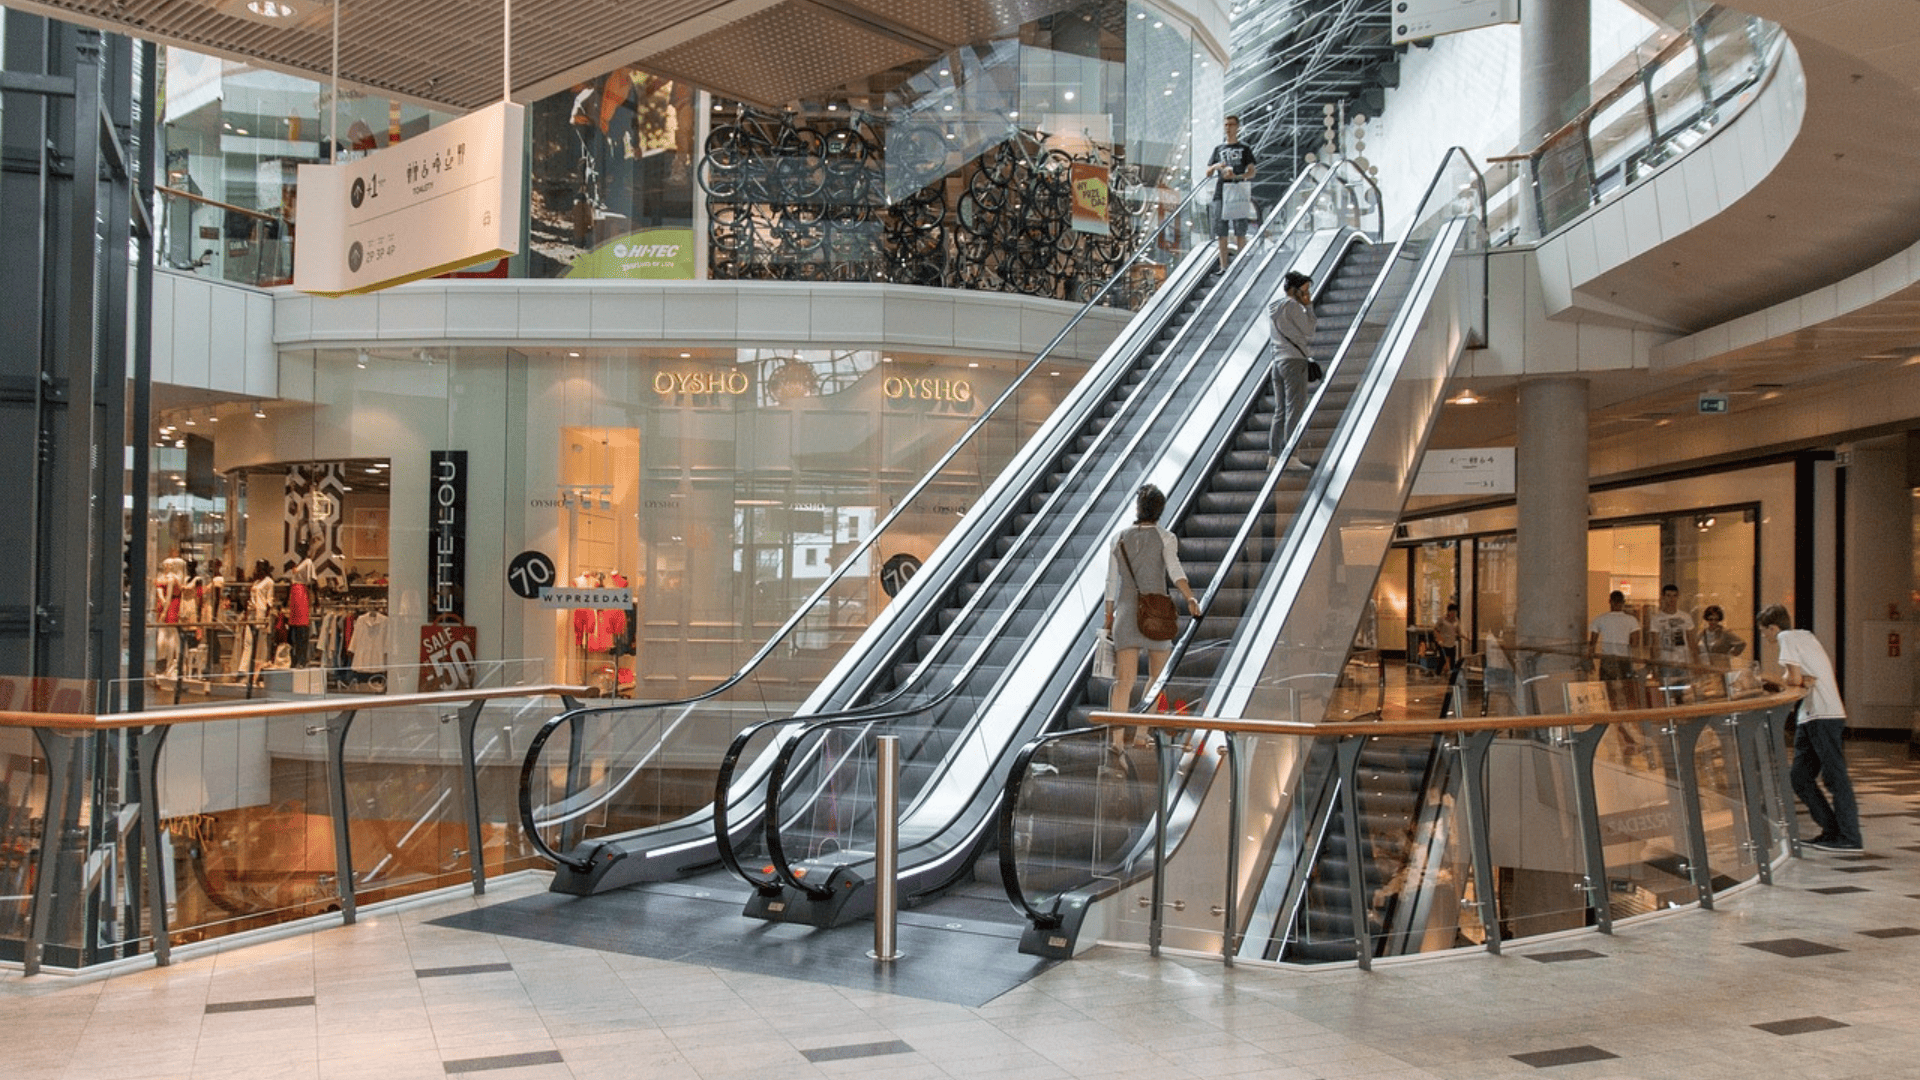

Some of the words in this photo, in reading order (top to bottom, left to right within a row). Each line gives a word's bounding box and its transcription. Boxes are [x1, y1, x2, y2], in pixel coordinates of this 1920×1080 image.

[366, 173, 379, 198] +1
[653, 371, 749, 395] OYSHO
[884, 376, 970, 402] OYSHO
[510, 558, 549, 595] 70
[543, 593, 630, 603] WYPRZEDAŻ
[423, 627, 455, 653] SALE
